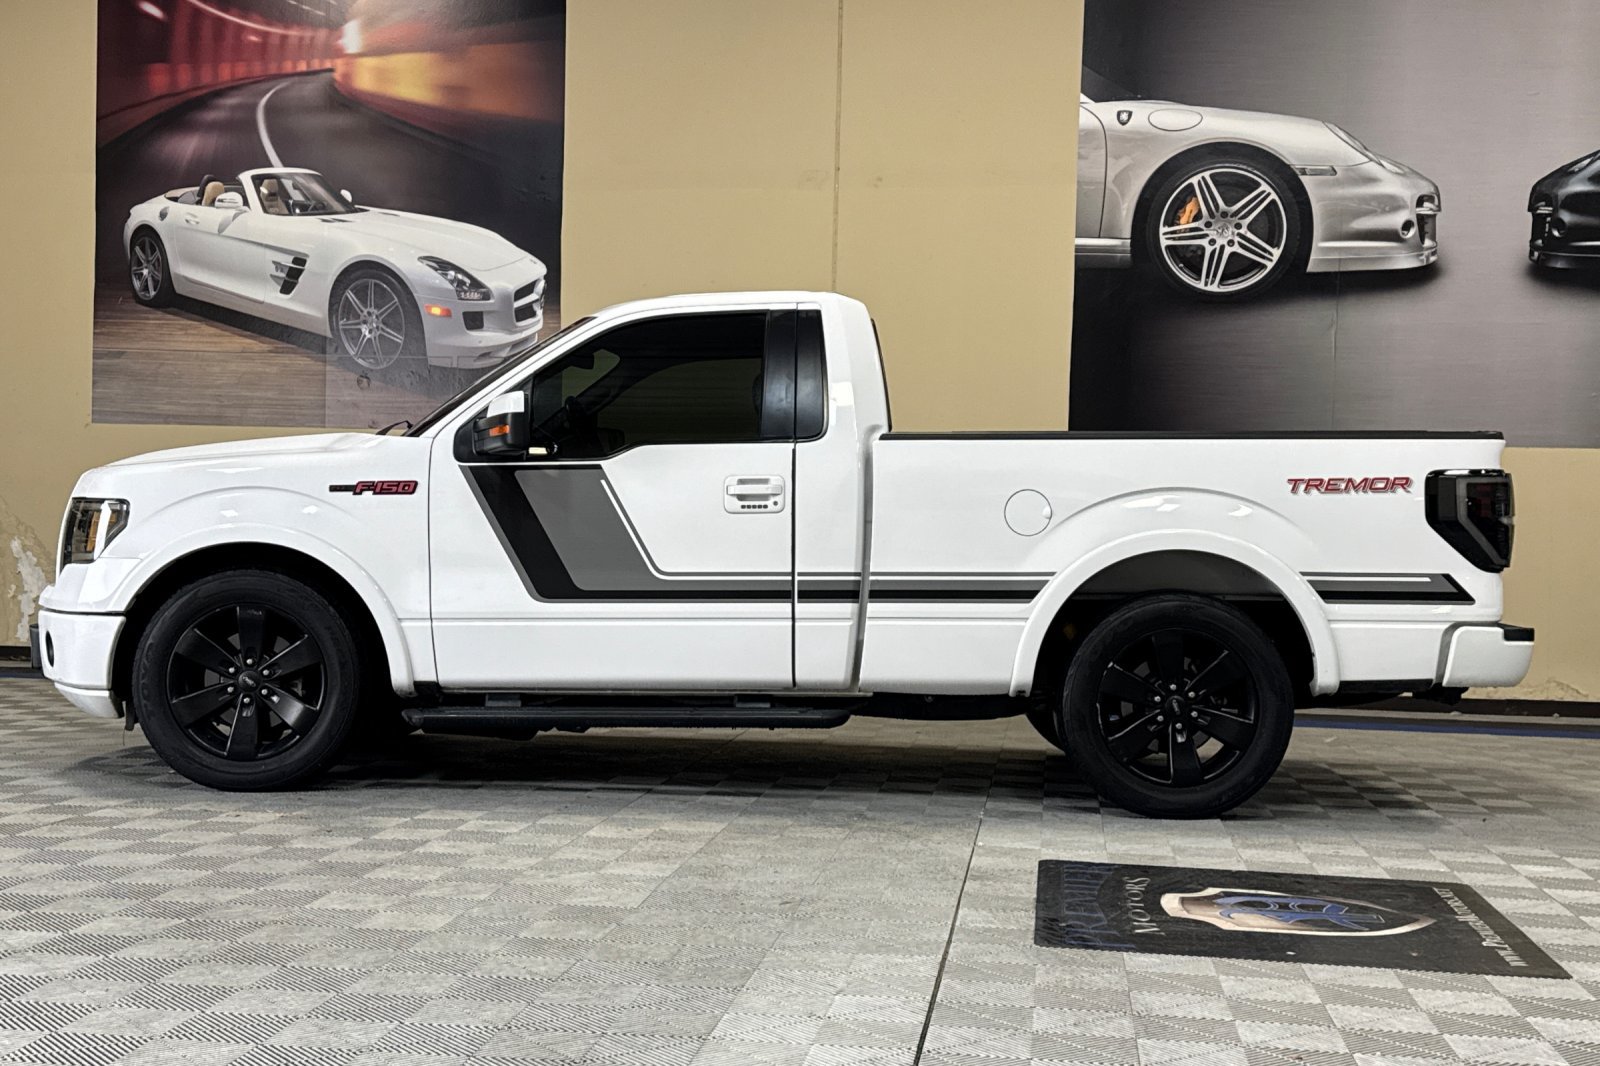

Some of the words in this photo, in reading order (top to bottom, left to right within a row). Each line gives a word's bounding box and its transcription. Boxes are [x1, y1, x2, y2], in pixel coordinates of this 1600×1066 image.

[353, 480, 418, 495] F-150
[1287, 476, 1413, 495] TREMOR
[1062, 864, 1136, 948] PREMIER
[1122, 876, 1166, 936] MOTORS
